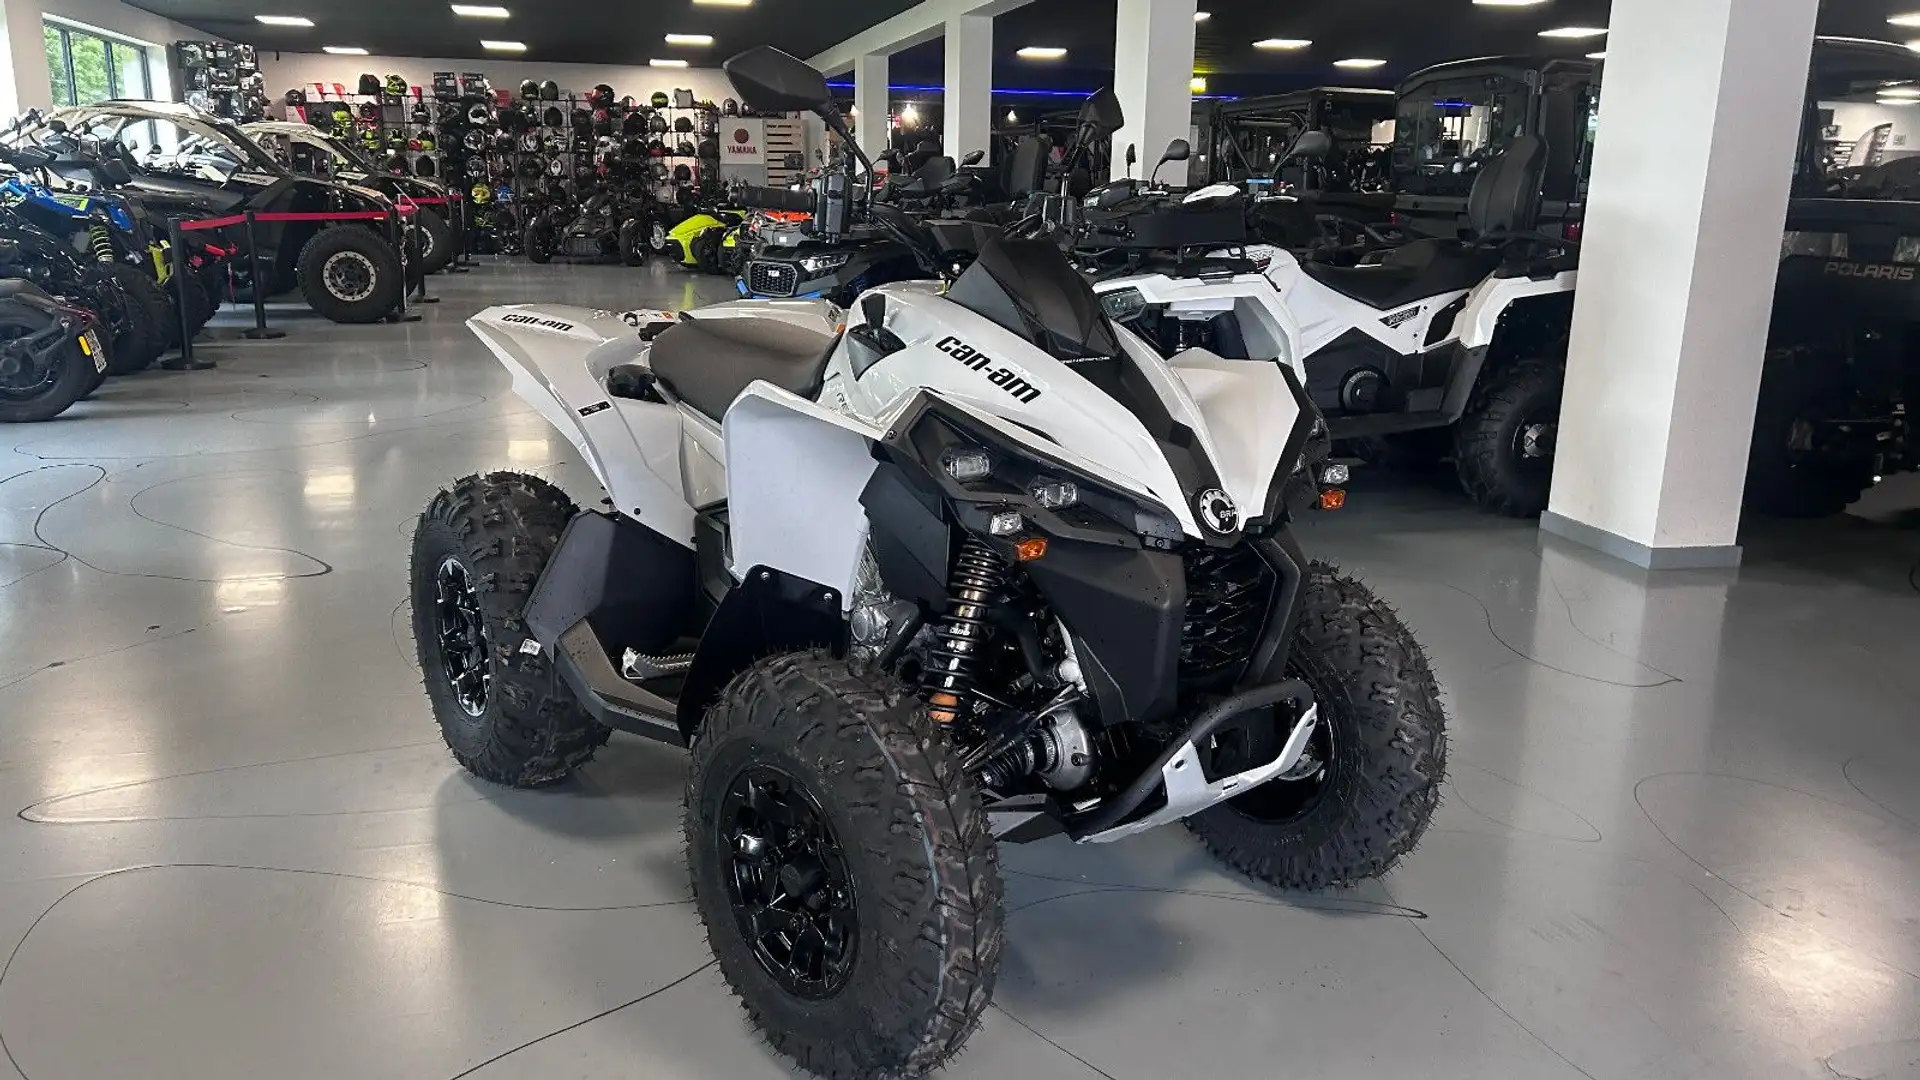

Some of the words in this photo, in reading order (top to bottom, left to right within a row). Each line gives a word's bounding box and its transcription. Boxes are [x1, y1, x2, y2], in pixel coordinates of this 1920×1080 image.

[727, 145, 758, 155] YAMAHA
[1823, 261, 1915, 281] POLARIS
[501, 314, 574, 332] can-am
[935, 335, 1042, 404] can-am
